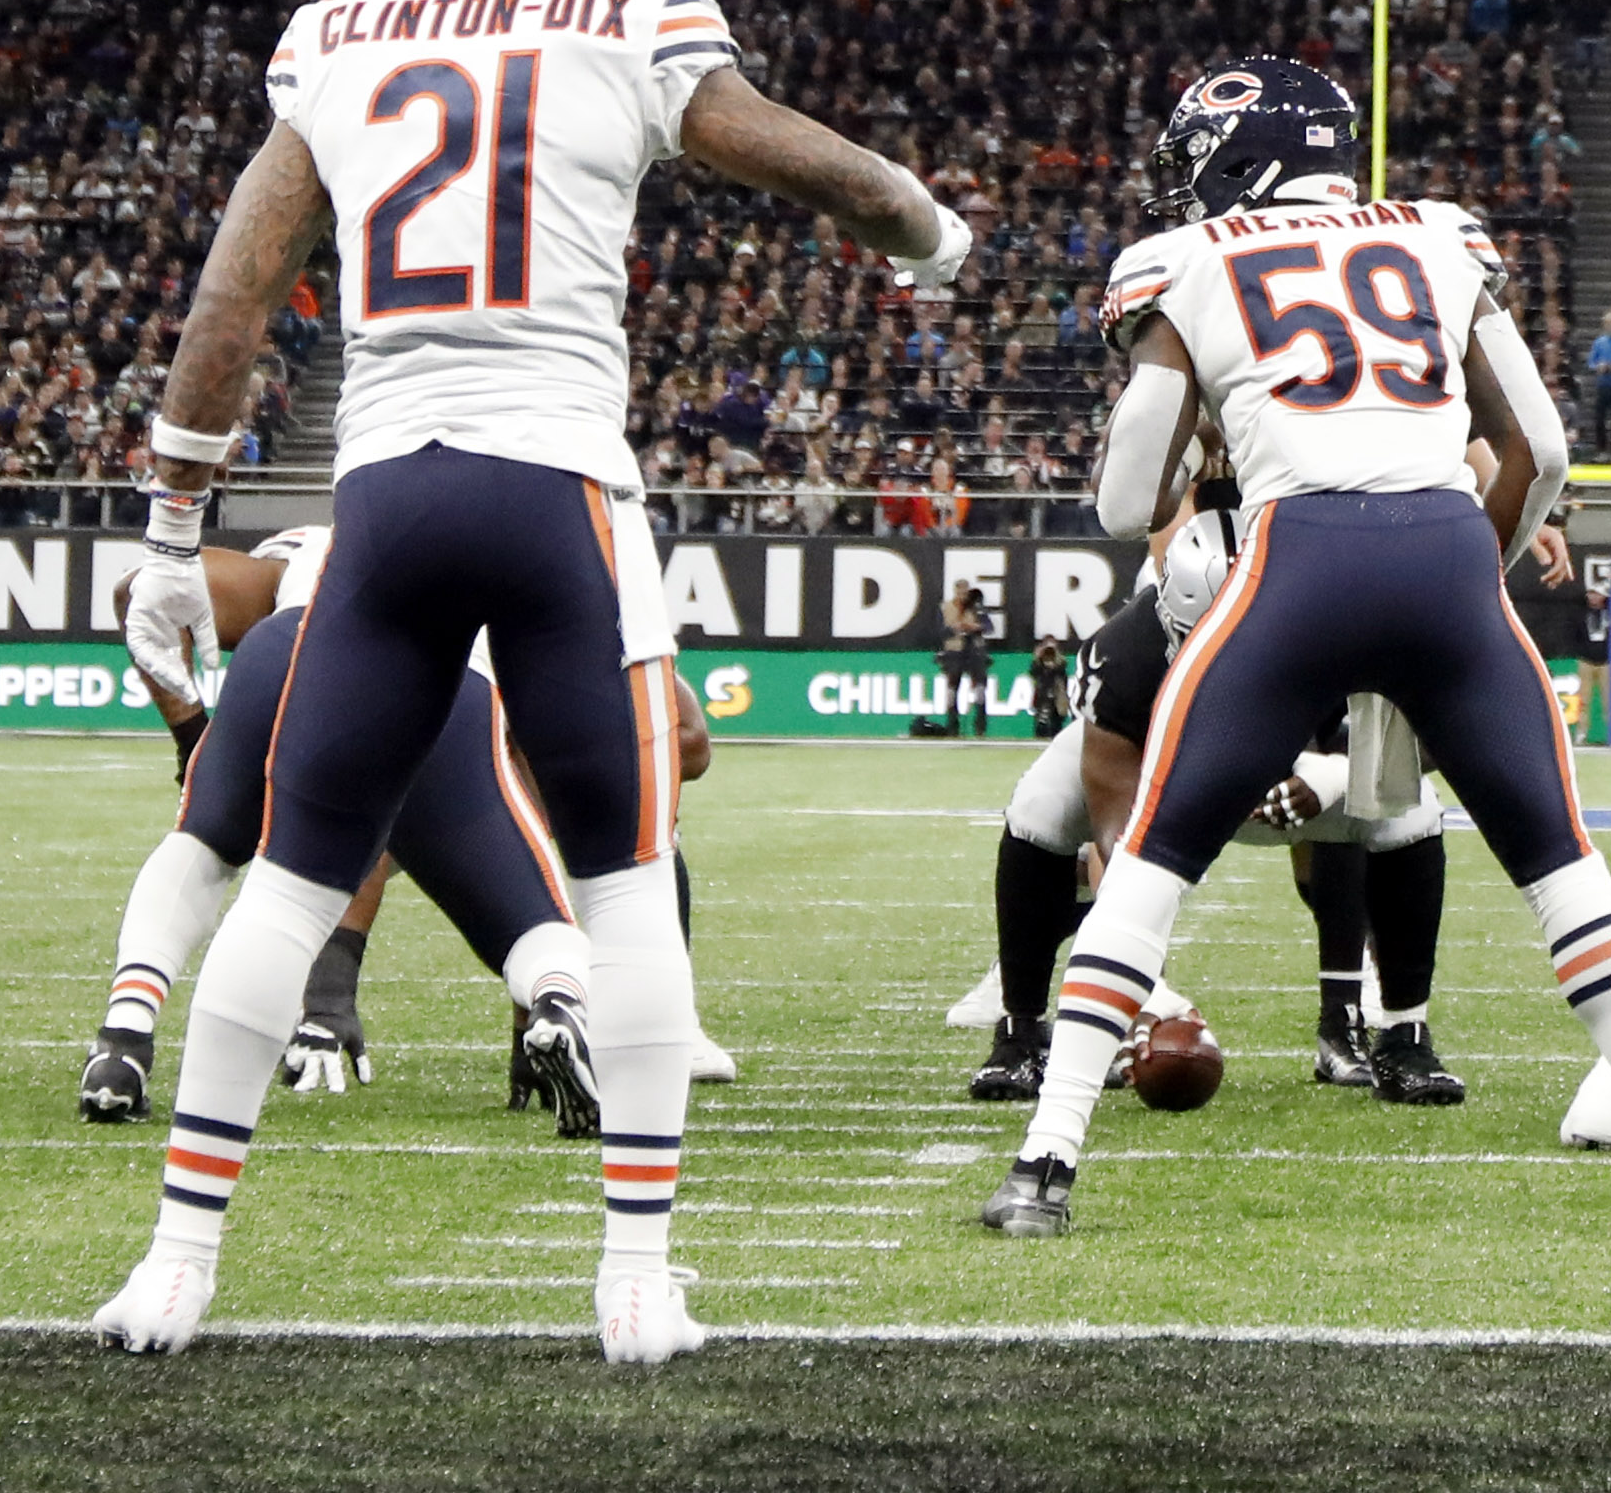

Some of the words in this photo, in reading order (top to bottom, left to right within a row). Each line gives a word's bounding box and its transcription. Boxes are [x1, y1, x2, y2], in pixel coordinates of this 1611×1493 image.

[362, 49, 541, 321] 21
[1223, 240, 1454, 412] 59
[661, 544, 1114, 641] AIDER
[808, 673, 946, 715] CHILLI
